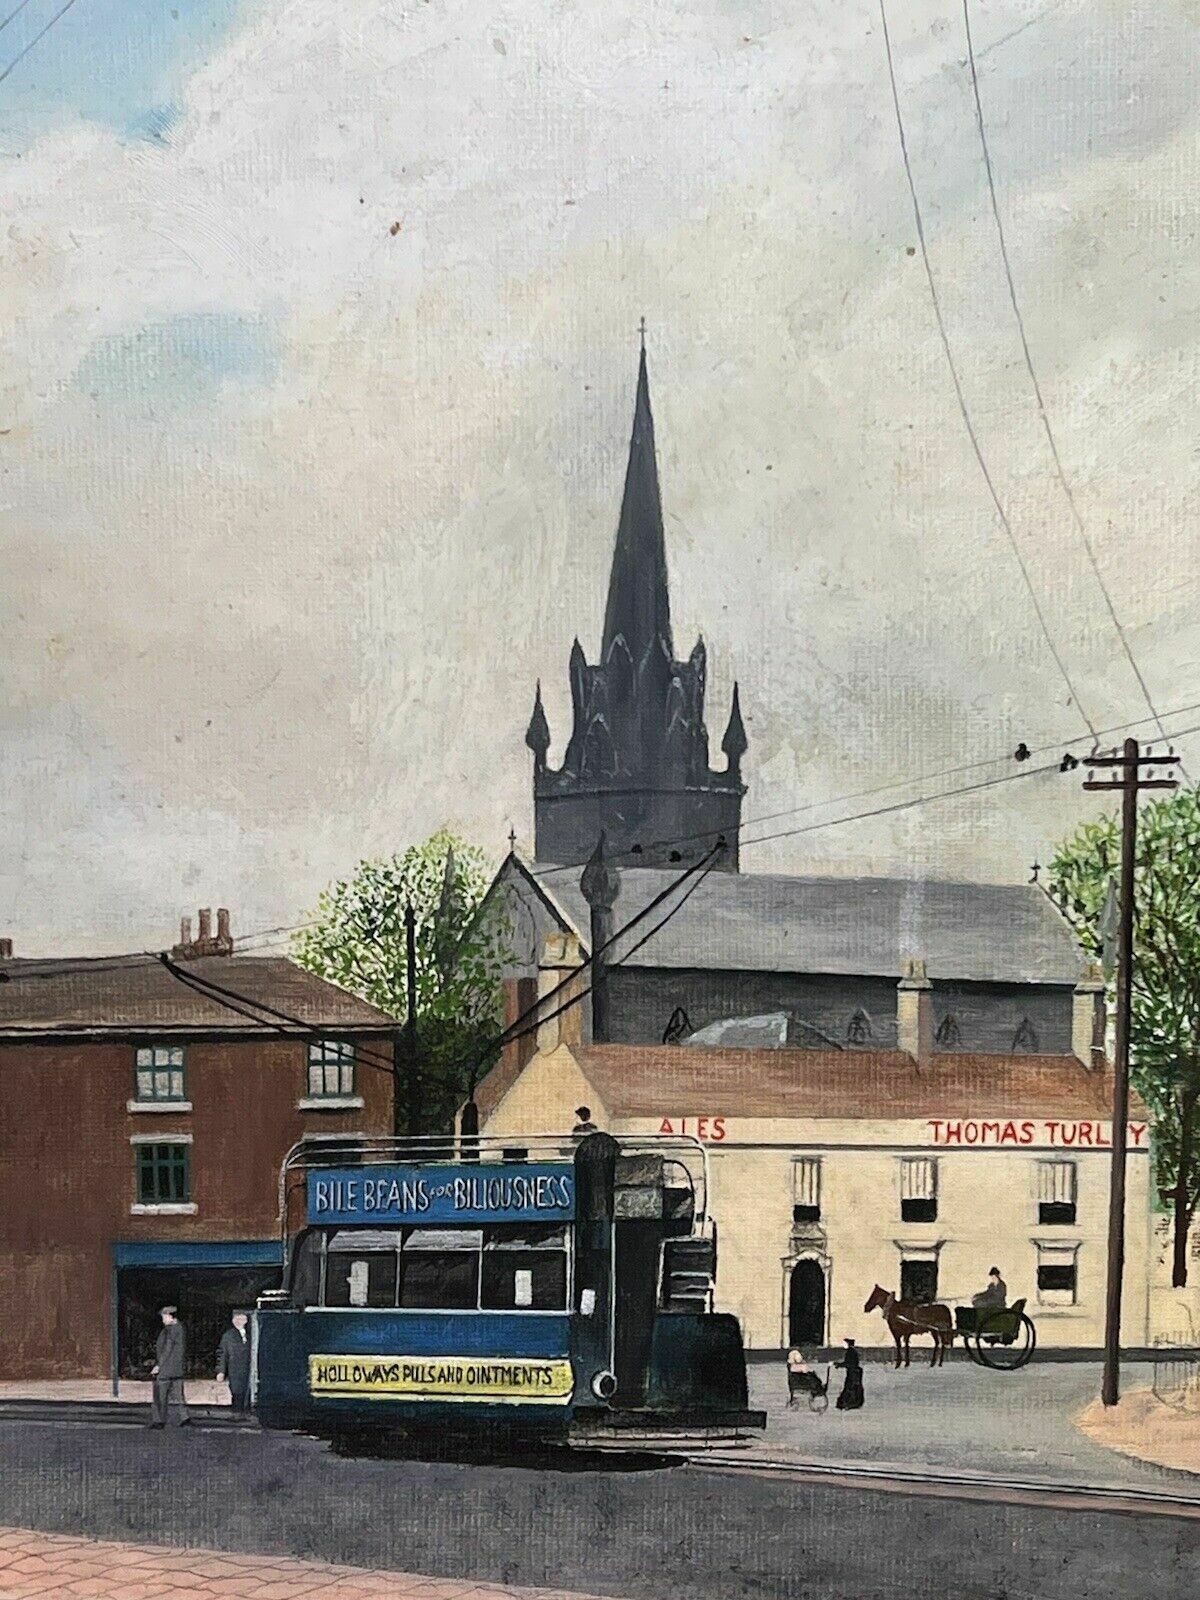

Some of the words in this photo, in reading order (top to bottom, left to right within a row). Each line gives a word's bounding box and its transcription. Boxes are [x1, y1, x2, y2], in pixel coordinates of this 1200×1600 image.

[928, 1120, 1035, 1145] THOMAS
[1044, 1122, 1147, 1146] TURLY
[315, 1180, 358, 1213] BILE
[363, 1179, 431, 1213] BEANS
[453, 1175, 571, 1211] BILIOUSNESS
[466, 1366, 553, 1386] OINTMENTS
